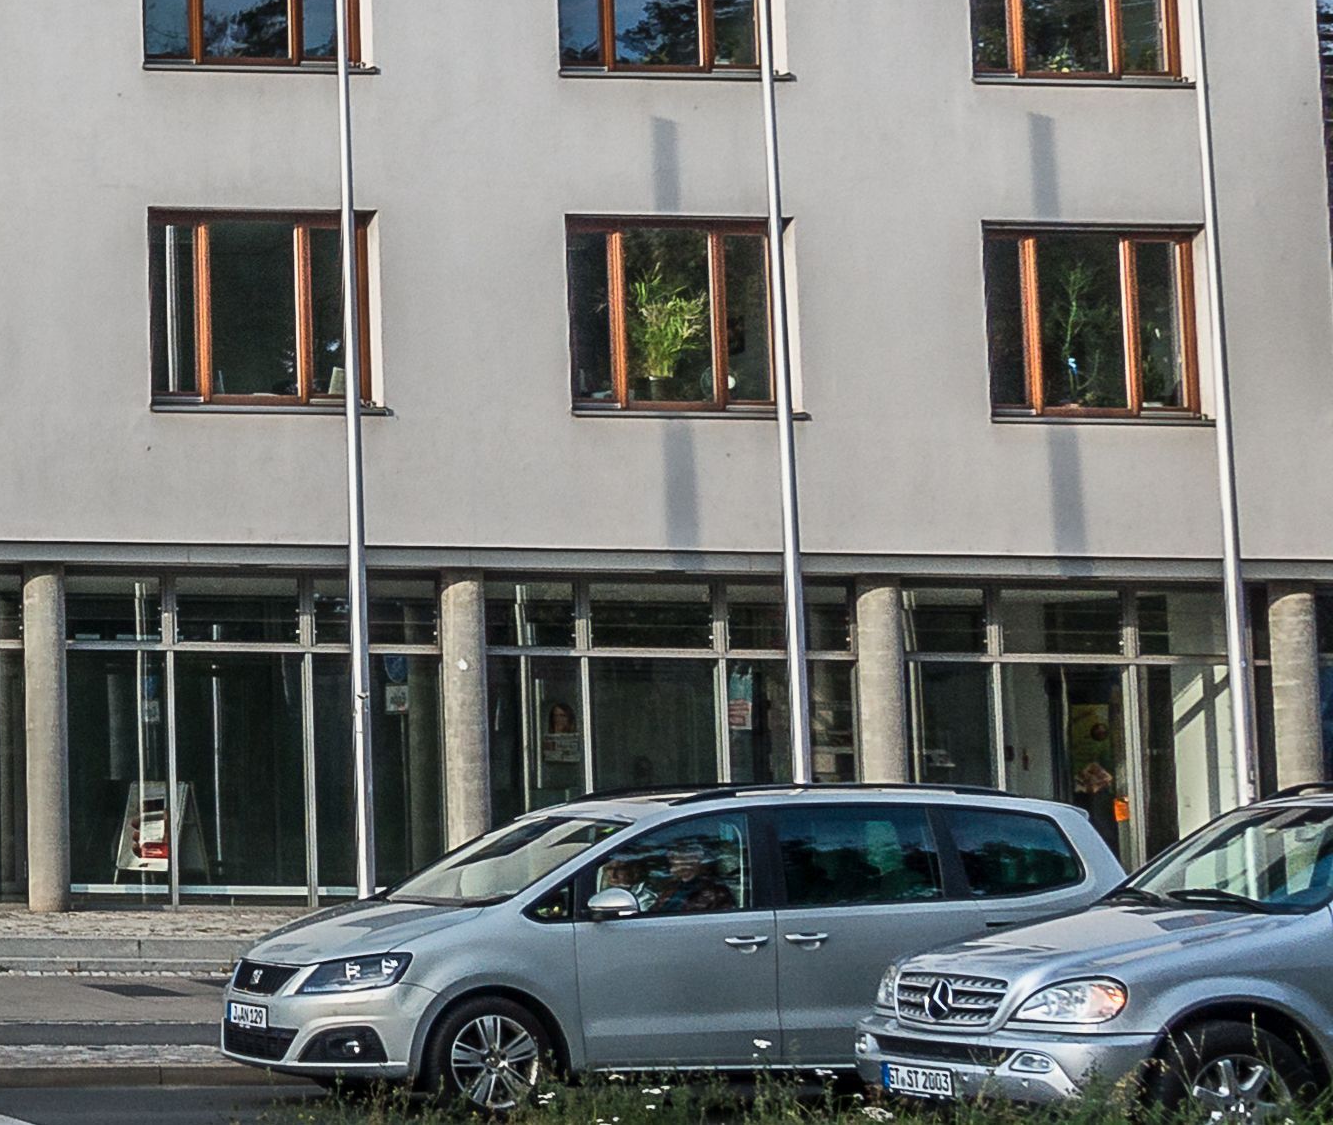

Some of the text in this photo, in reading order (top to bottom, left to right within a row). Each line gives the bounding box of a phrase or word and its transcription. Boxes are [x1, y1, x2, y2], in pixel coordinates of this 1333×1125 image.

[250, 1008, 264, 1025] 129
[906, 1070, 919, 1088] ST
[921, 1071, 949, 1092] 2003
